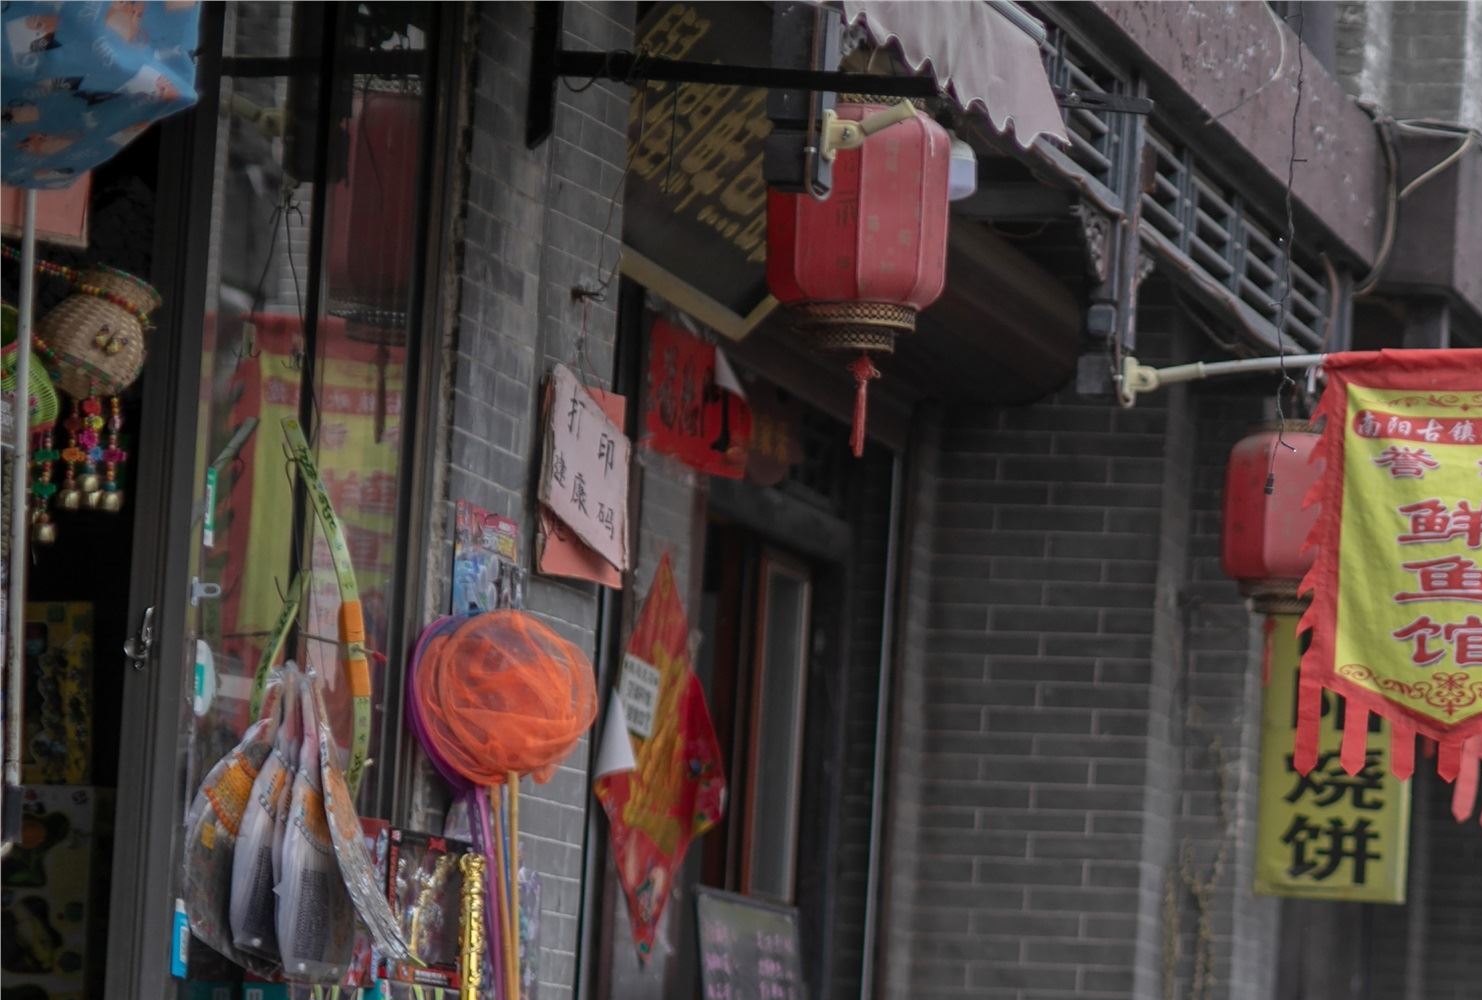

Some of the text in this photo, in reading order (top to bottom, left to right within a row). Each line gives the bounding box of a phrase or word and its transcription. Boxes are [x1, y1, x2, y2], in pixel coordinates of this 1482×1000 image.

[567, 384, 614, 480] 打印
[554, 451, 615, 541] 健康码
